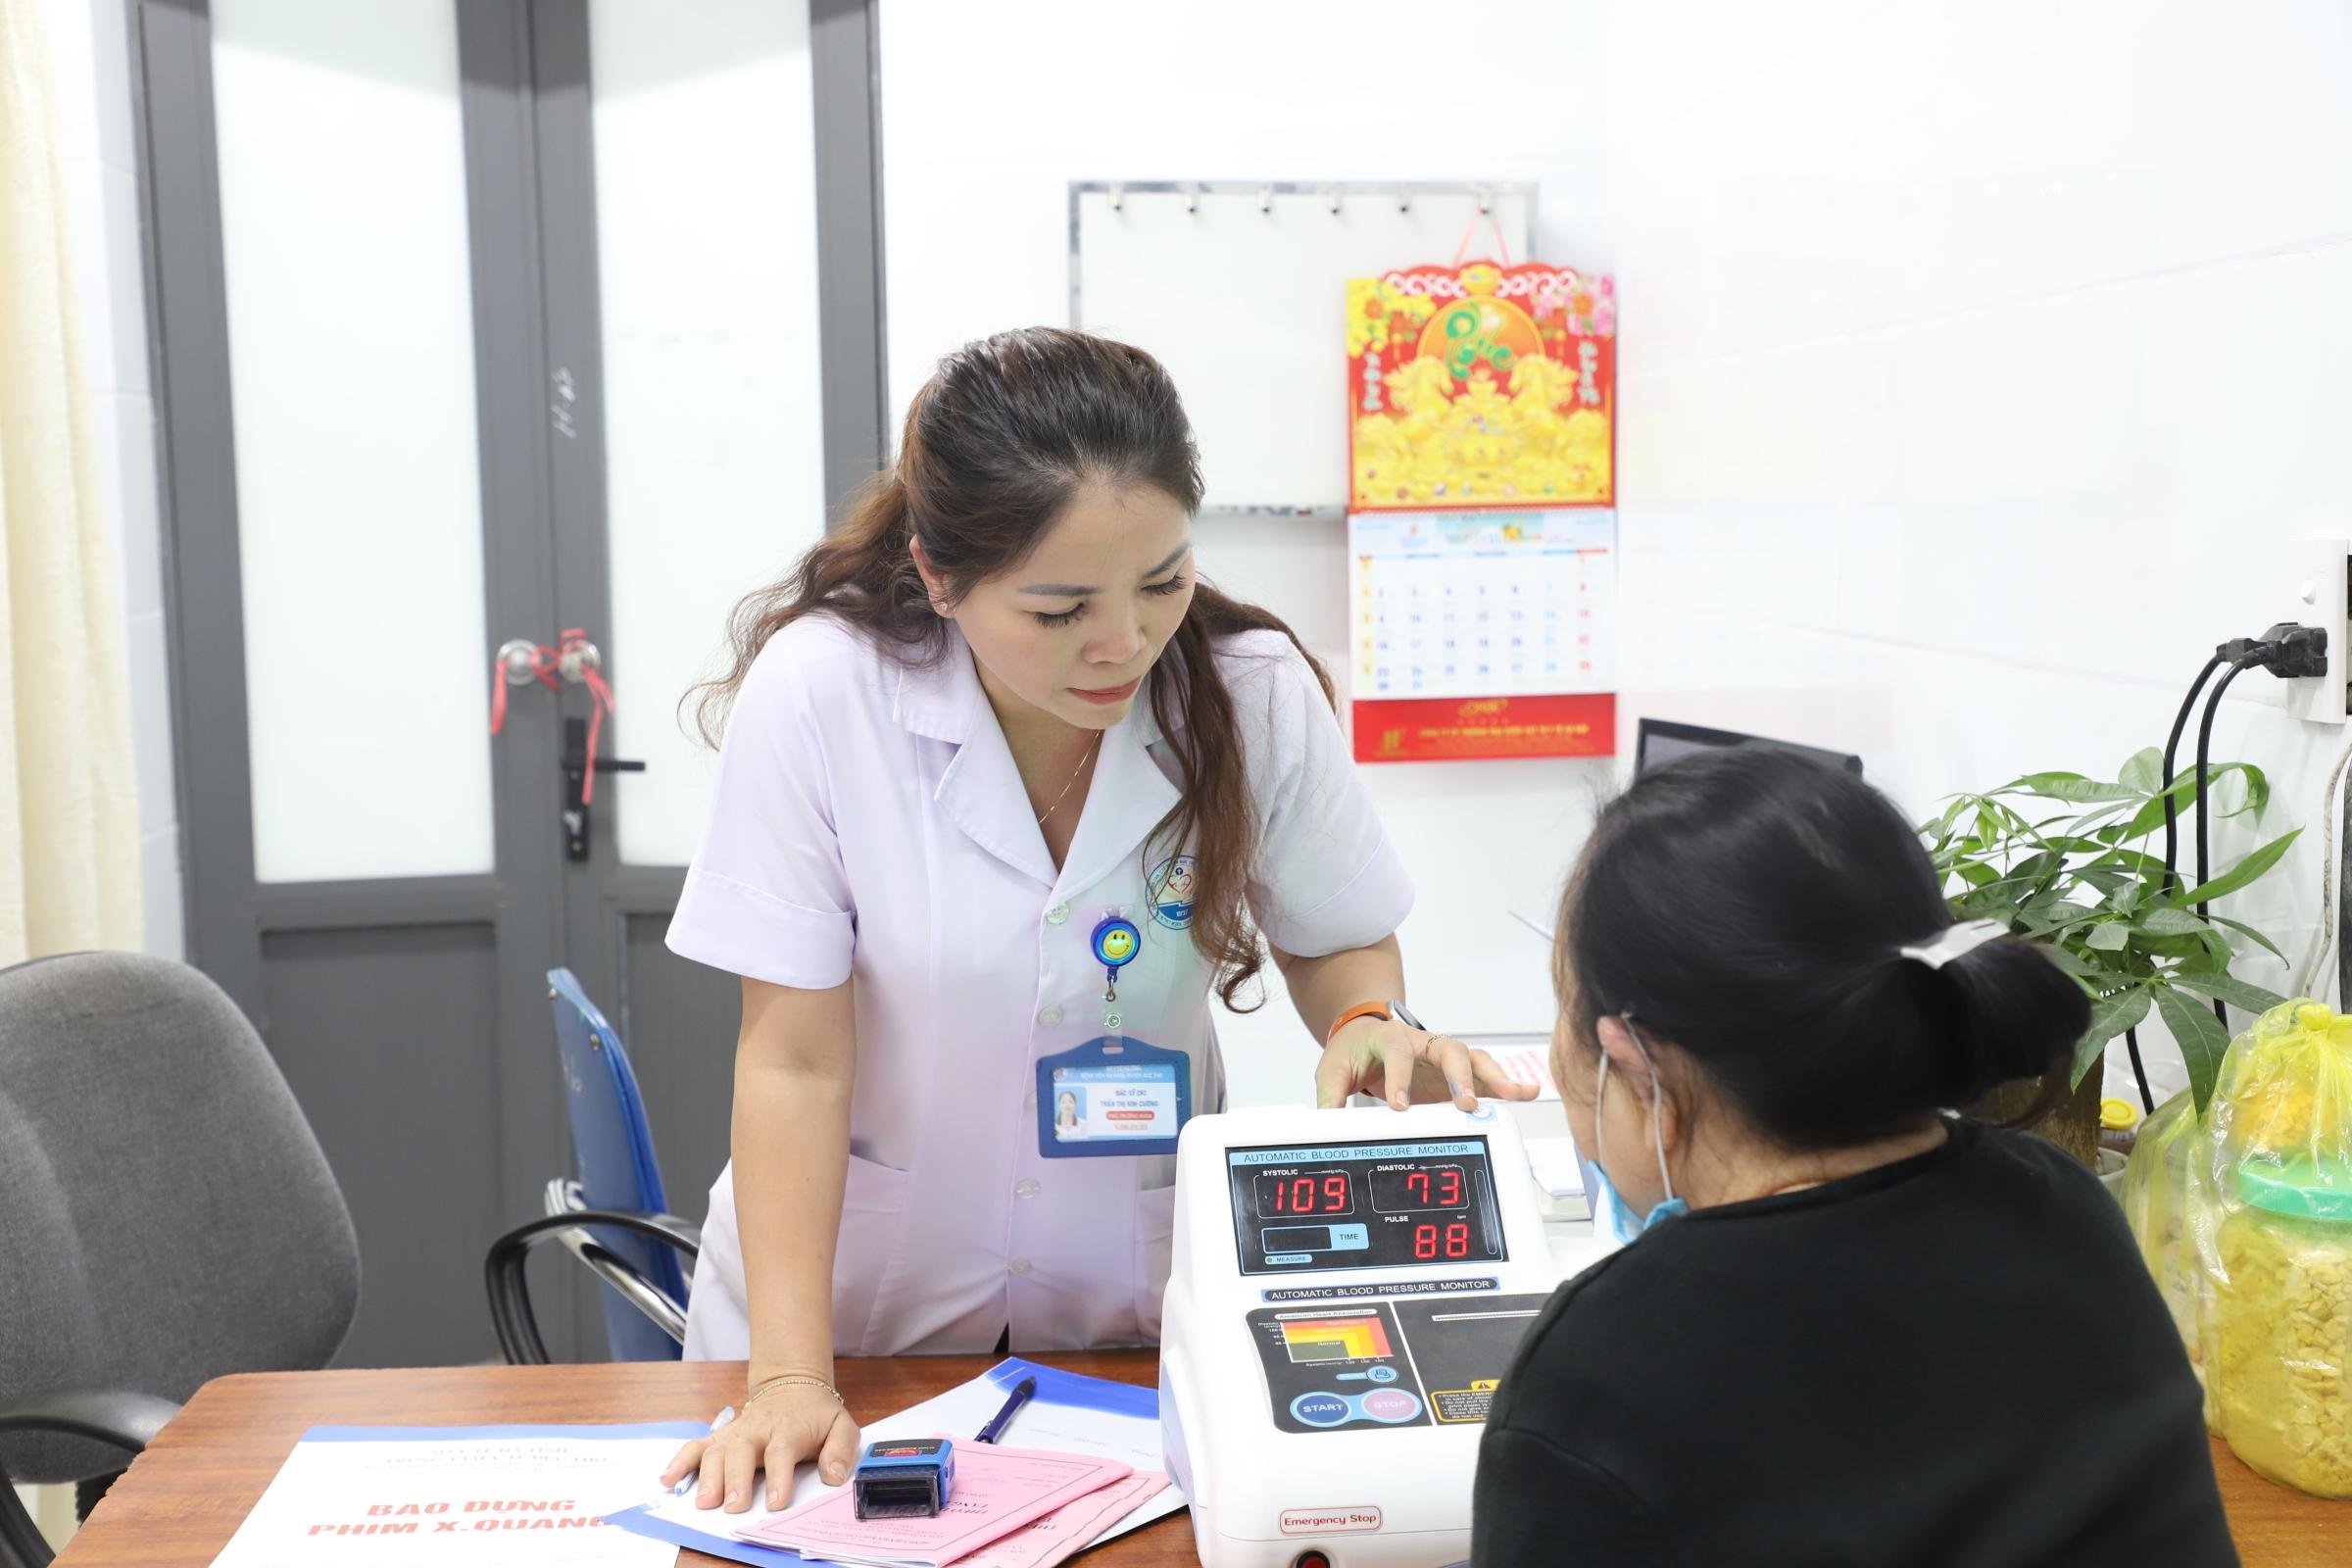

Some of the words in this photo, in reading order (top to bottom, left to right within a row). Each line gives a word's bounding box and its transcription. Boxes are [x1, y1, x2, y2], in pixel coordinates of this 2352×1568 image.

[1244, 1152, 1305, 1163] AUTOMATIC
[1311, 1150, 1348, 1159] BLOOD
[1354, 1147, 1412, 1157] PRESSURE
[1418, 1145, 1468, 1154] MONITOR
[1377, 1163, 1415, 1172] DIASTOLIC
[1276, 1177, 1347, 1212] 109
[1407, 1171, 1459, 1205] 73
[1415, 1223, 1469, 1259] 88
[1271, 1289, 1333, 1300] AUTOMATIC
[1337, 1287, 1374, 1297] BLOOD
[1378, 1283, 1436, 1294] PRESSURE
[1441, 1280, 1491, 1291] MONITOR
[1302, 1403, 1344, 1413] START
[1373, 1399, 1406, 1409] STOP
[366, 1502, 450, 1516] BAO
[1284, 1516, 1347, 1526] Emergency
[1349, 1514, 1377, 1524] Stop
[307, 1522, 419, 1536] PHIM
